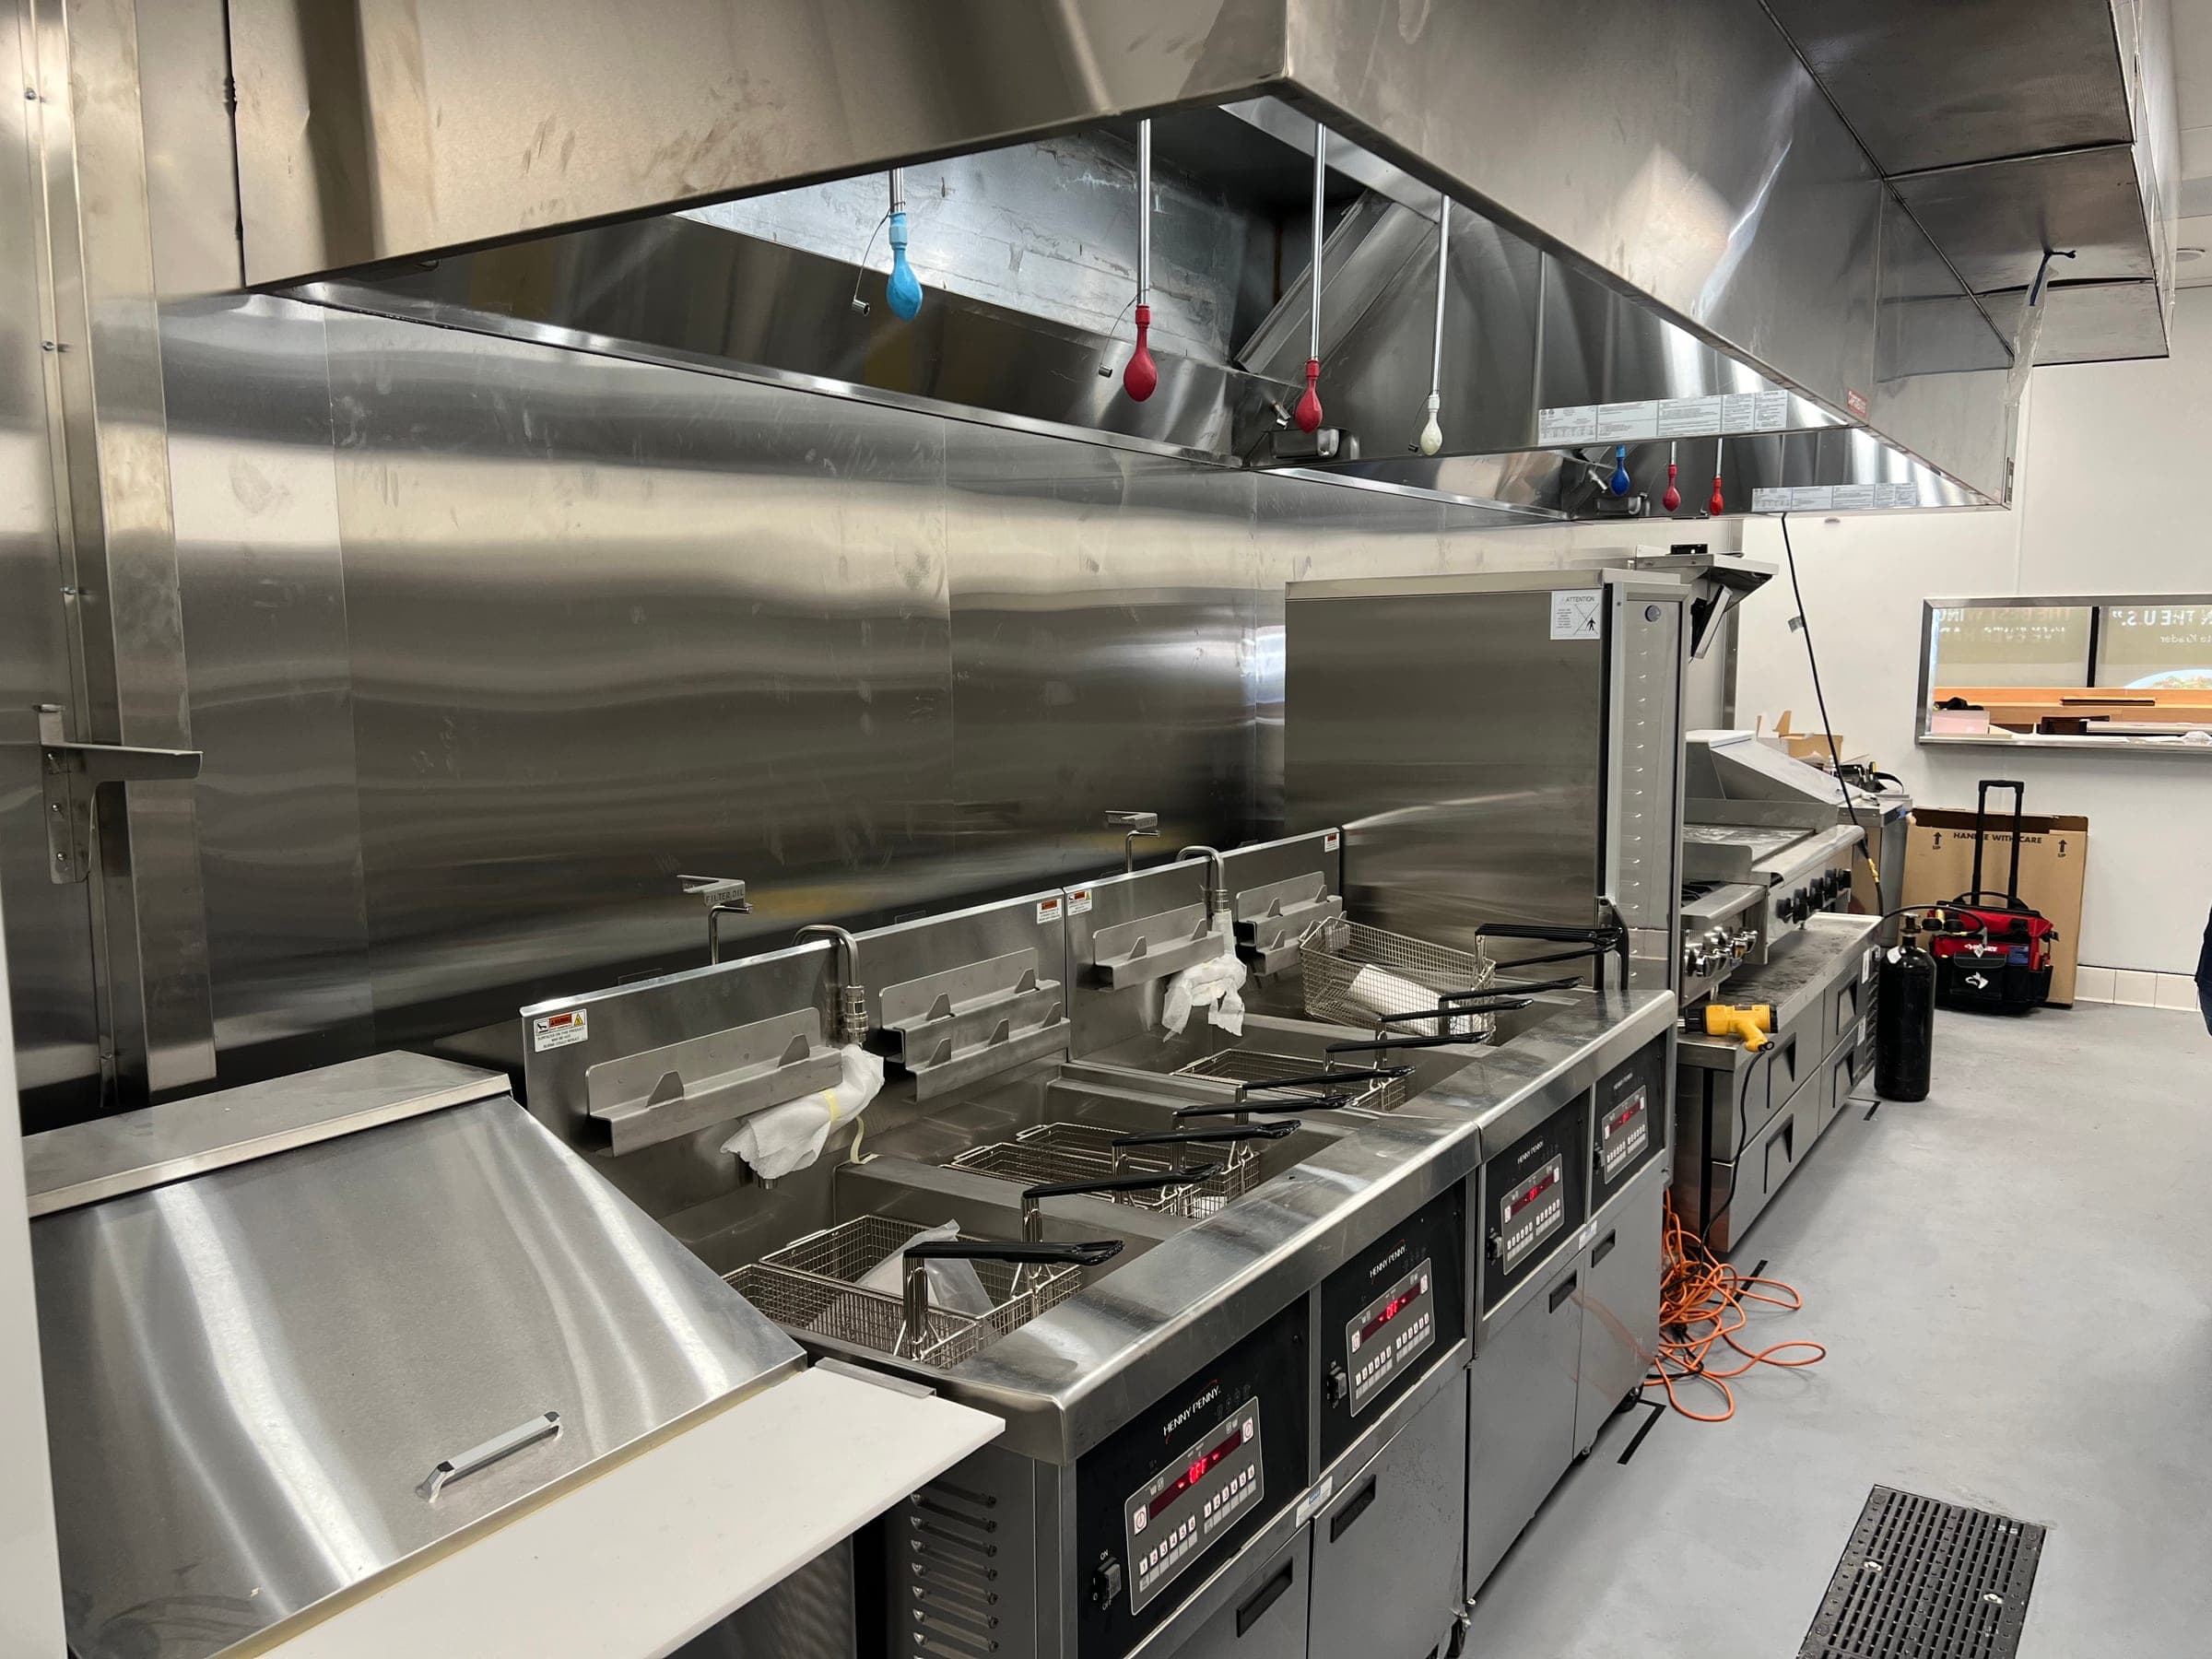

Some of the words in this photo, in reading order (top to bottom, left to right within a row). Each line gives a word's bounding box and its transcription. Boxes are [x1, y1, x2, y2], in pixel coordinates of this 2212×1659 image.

[1953, 832, 1990, 841] HANE
[2019, 836, 2042, 844] CARE
[705, 891, 731, 903] FILTER
[732, 888, 744, 898] OIL
[1163, 1406, 1192, 1437] HENNY
[1192, 1384, 1220, 1414] PENNY
[1100, 1548, 1109, 1560] ON
